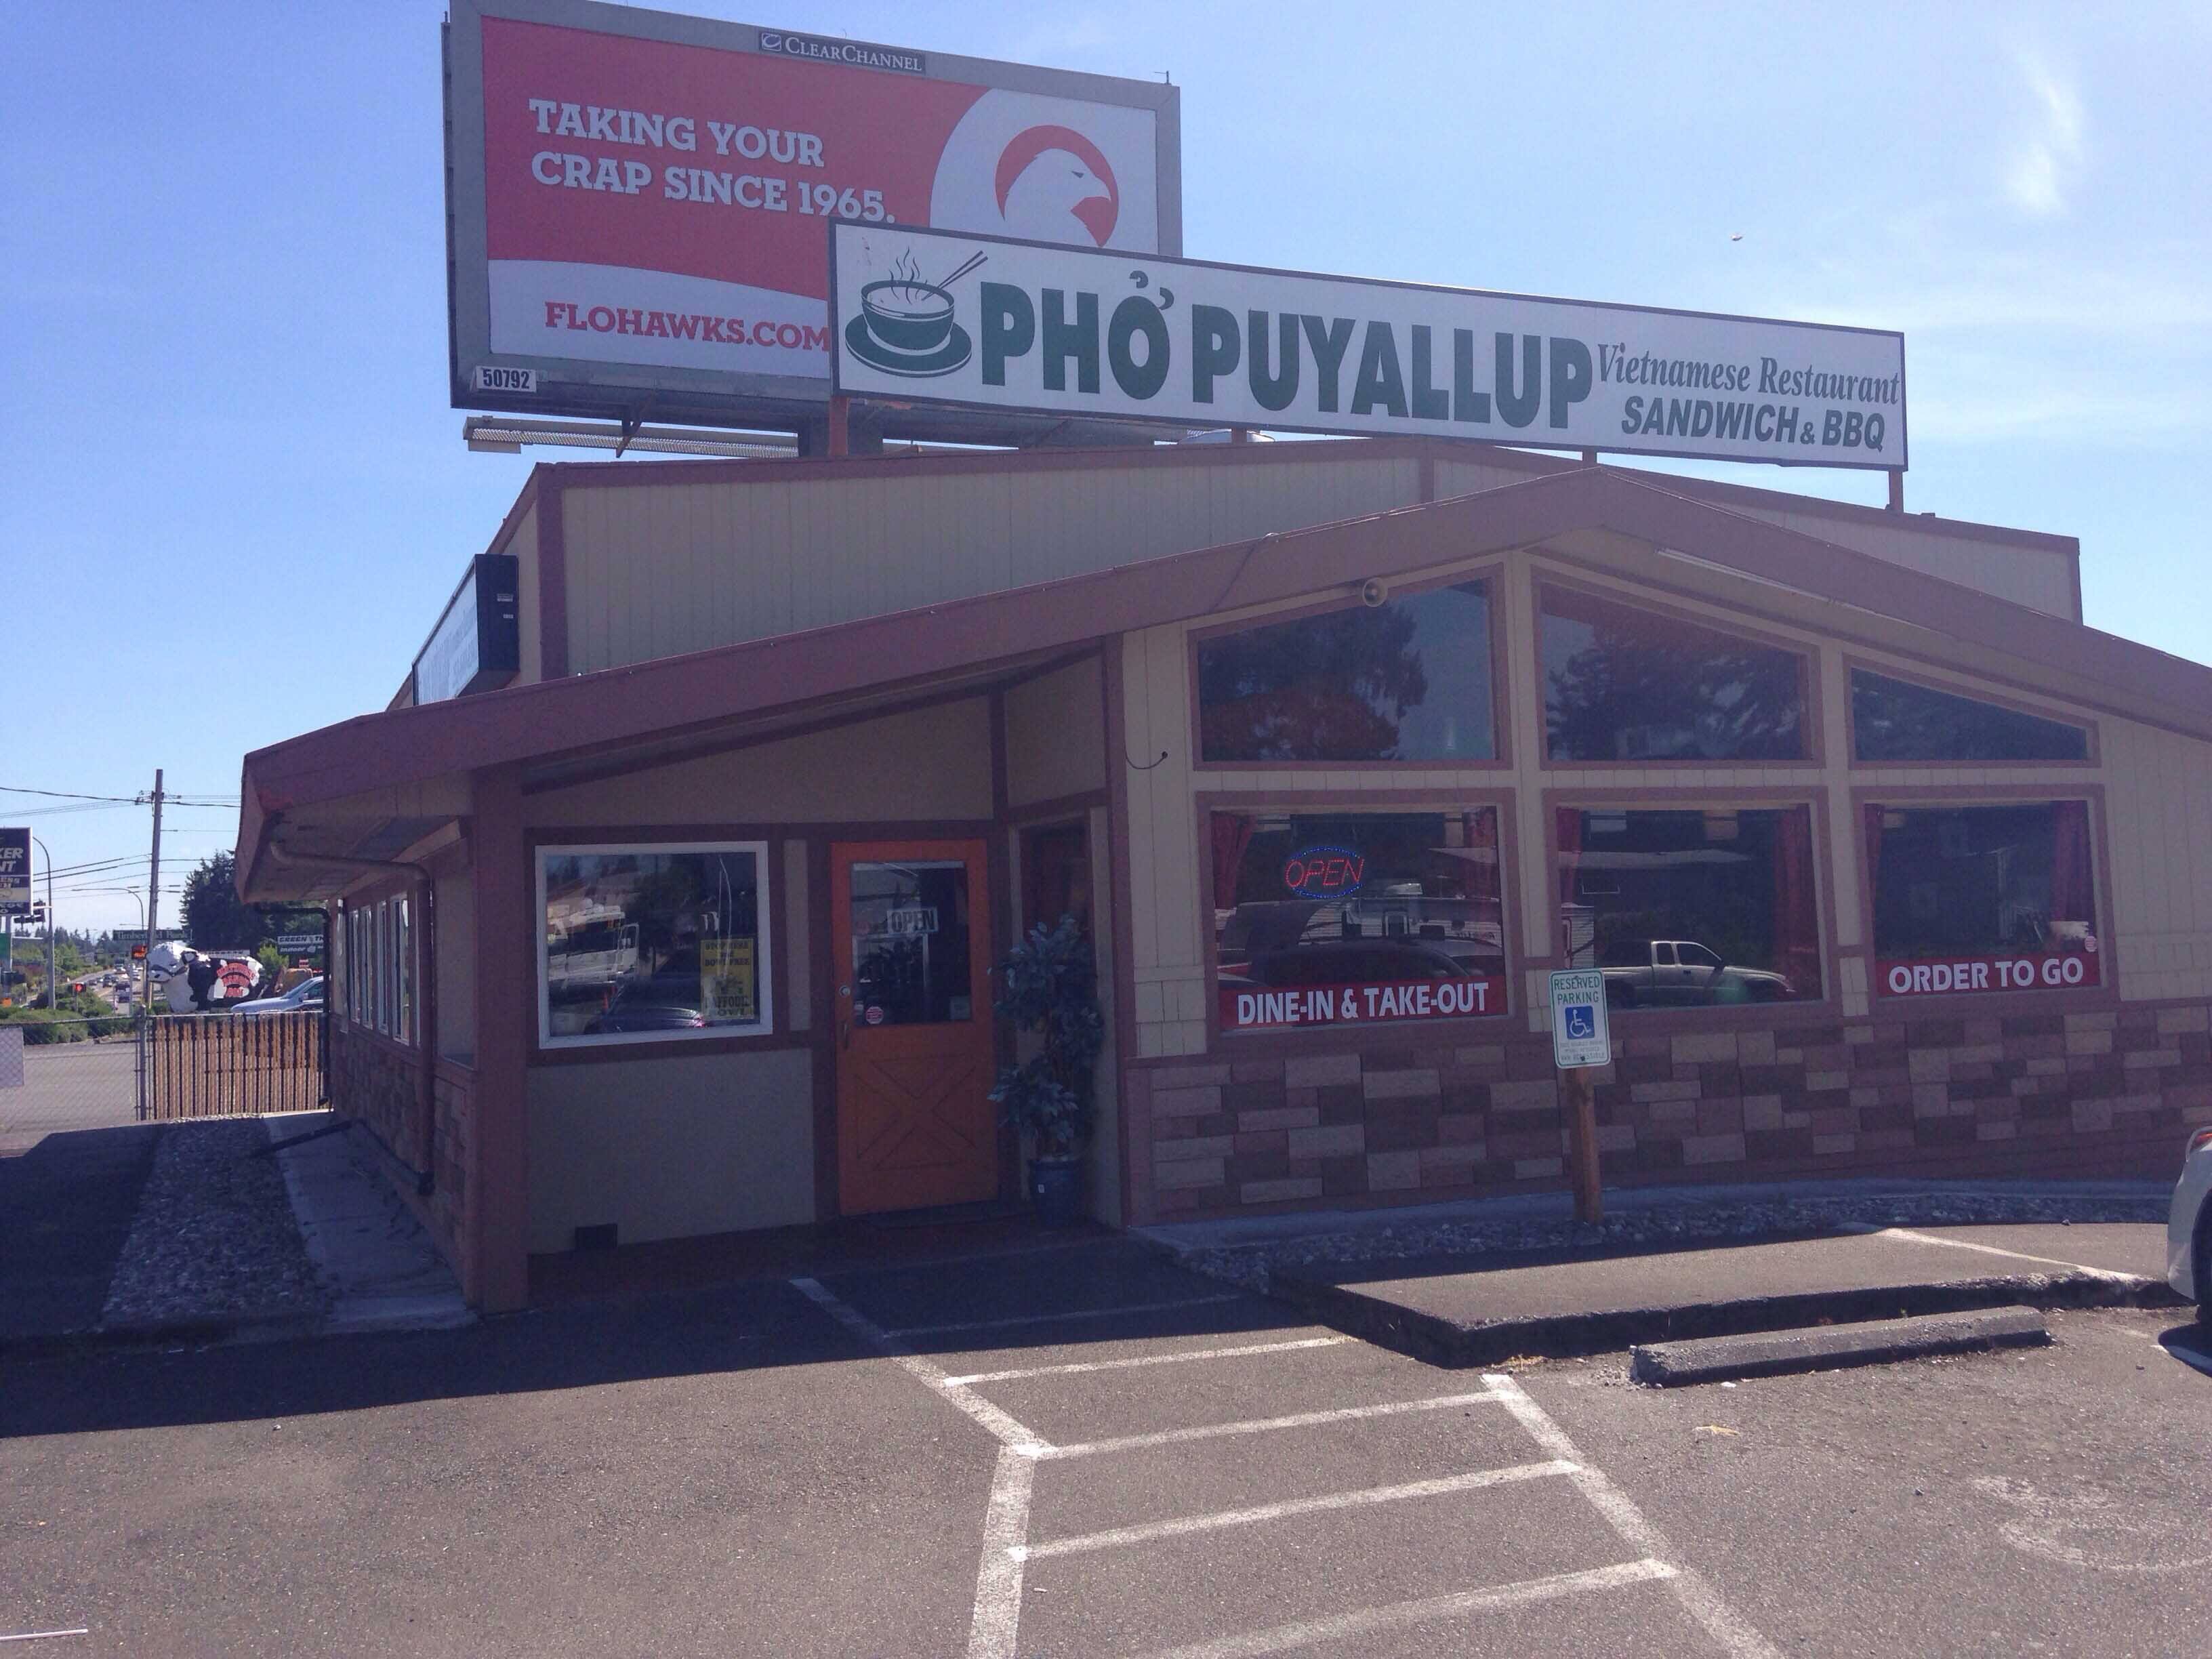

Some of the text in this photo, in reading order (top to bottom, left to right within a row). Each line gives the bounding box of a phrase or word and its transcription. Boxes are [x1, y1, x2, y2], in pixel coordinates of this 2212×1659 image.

[529, 98, 825, 168] TAKING YOUR
[531, 151, 896, 224] CRAP SINCE 1965.
[544, 302, 830, 352] FLOHAWKS.COM
[481, 367, 532, 390] 50792
[1191, 303, 1593, 430] PUYALLUP
[1597, 342, 1900, 405] Vietnamese Restaurant
[1621, 394, 1886, 453] SANDWICH & BBQ
[1286, 857, 1365, 888] OPEN
[891, 909, 935, 933] OPEN
[1554, 976, 1600, 991] RESERVED
[1889, 957, 2084, 994] ORDER TO GO
[1237, 982, 1490, 1026] DINE-IN & TAKE-OUT
[1557, 991, 1599, 1005] PARKING
